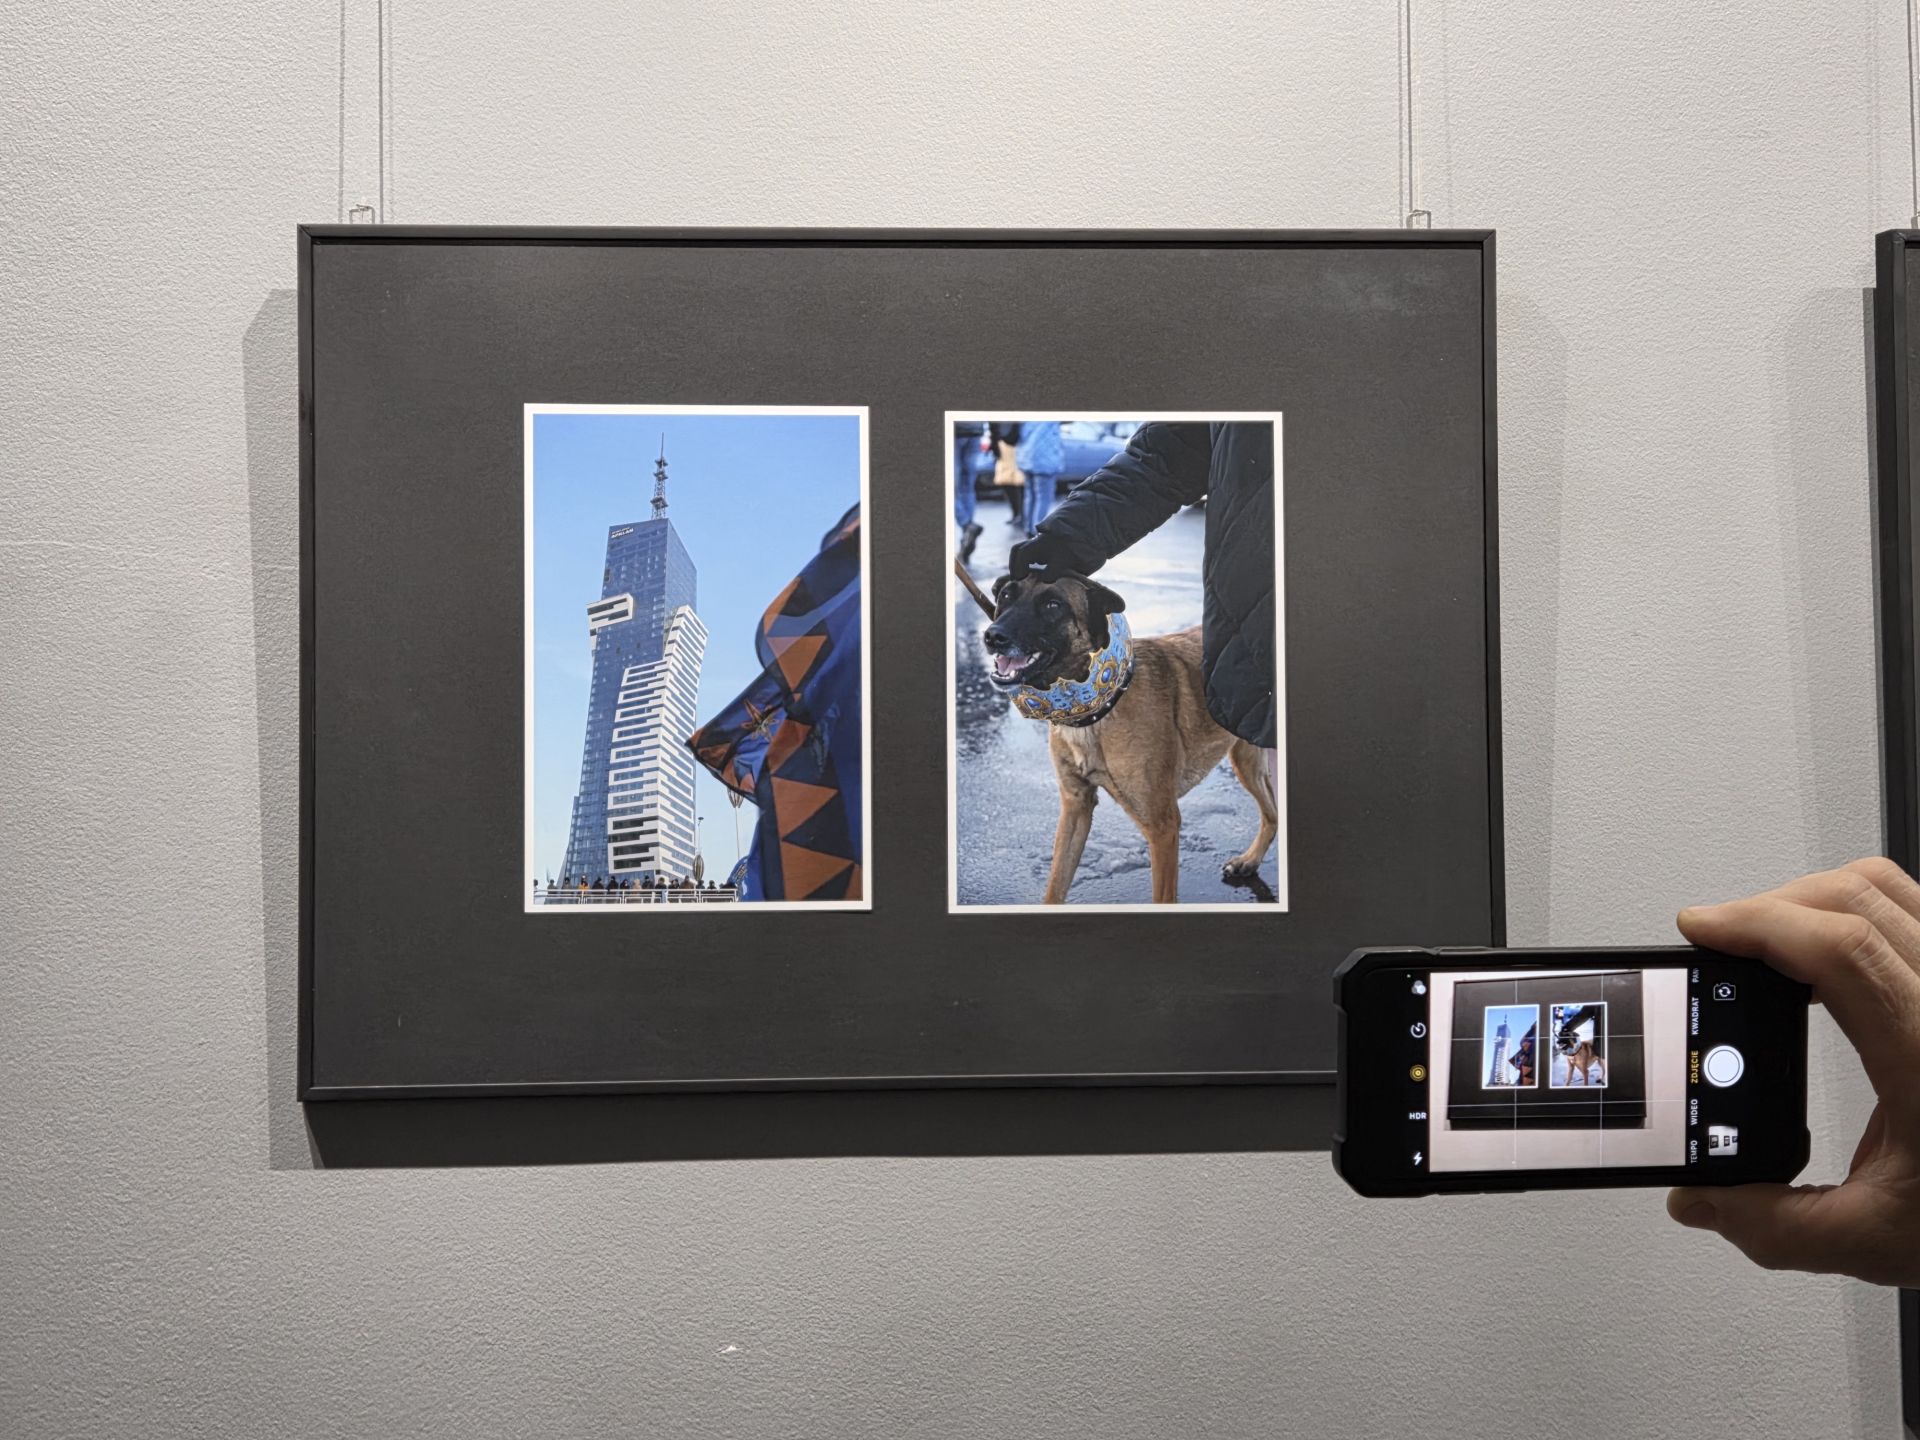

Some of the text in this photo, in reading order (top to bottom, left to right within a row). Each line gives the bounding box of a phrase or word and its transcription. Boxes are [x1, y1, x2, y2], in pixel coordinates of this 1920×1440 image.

[1691, 996, 1699, 1036] KWADRAT
[1691, 1050, 1699, 1084] ZDJĘCIE
[1408, 1112, 1427, 1120] HDR
[1690, 1098, 1698, 1126] WIDEO
[1690, 1139, 1698, 1164] TEMPO
